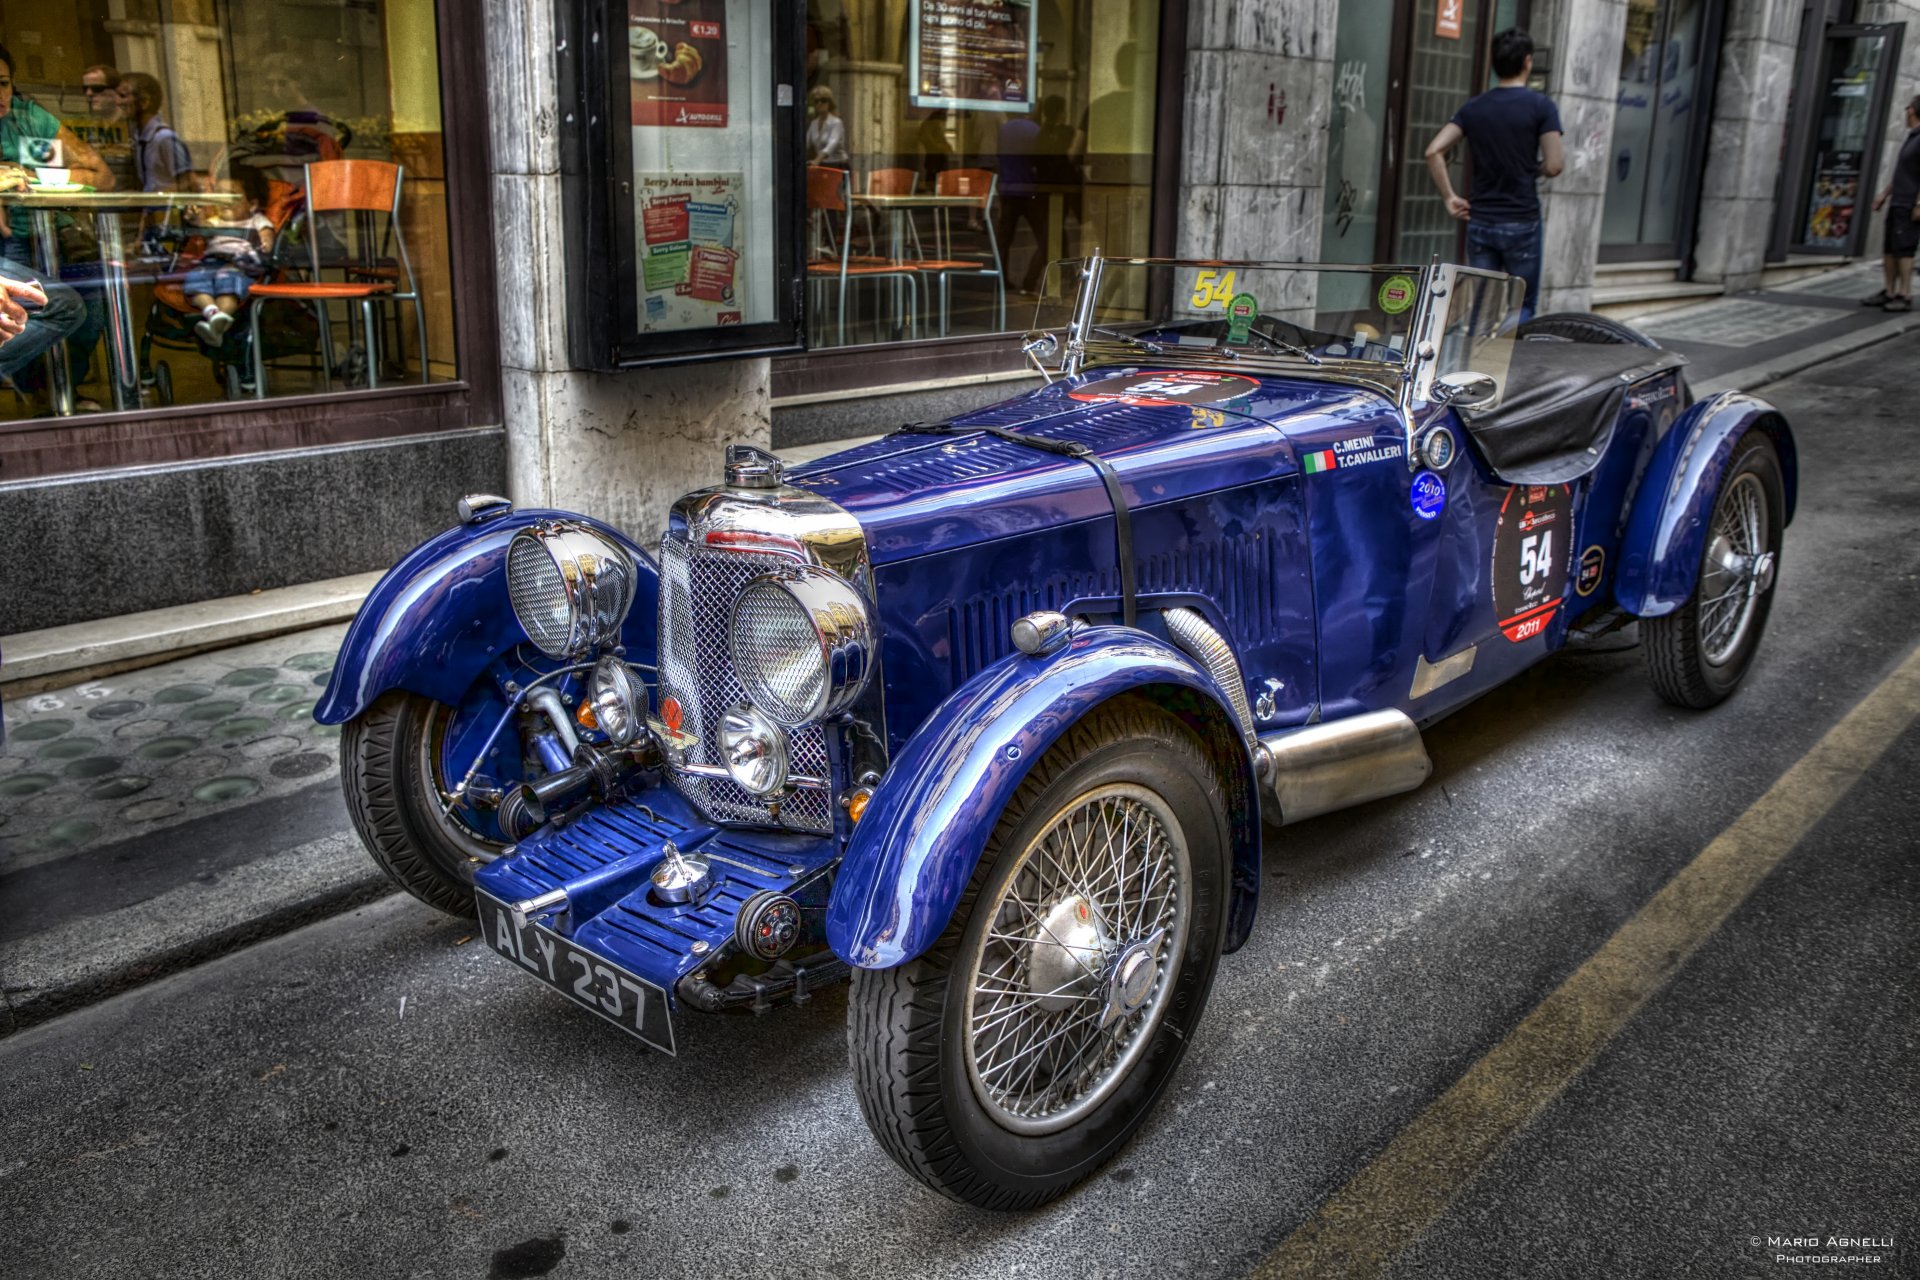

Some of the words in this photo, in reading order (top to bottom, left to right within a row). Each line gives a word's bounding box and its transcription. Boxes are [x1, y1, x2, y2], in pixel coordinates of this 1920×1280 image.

[1192, 270, 1236, 309] 54
[1125, 381, 1204, 396] 54
[1333, 435, 1375, 454] C.MEINI
[1337, 445, 1402, 469] T.CAVALLERI
[1418, 481, 1441, 496] 2010
[1520, 530, 1553, 586] 54
[1515, 618, 1541, 640] 2011
[496, 908, 556, 982] ALY
[567, 951, 646, 1031] 237
